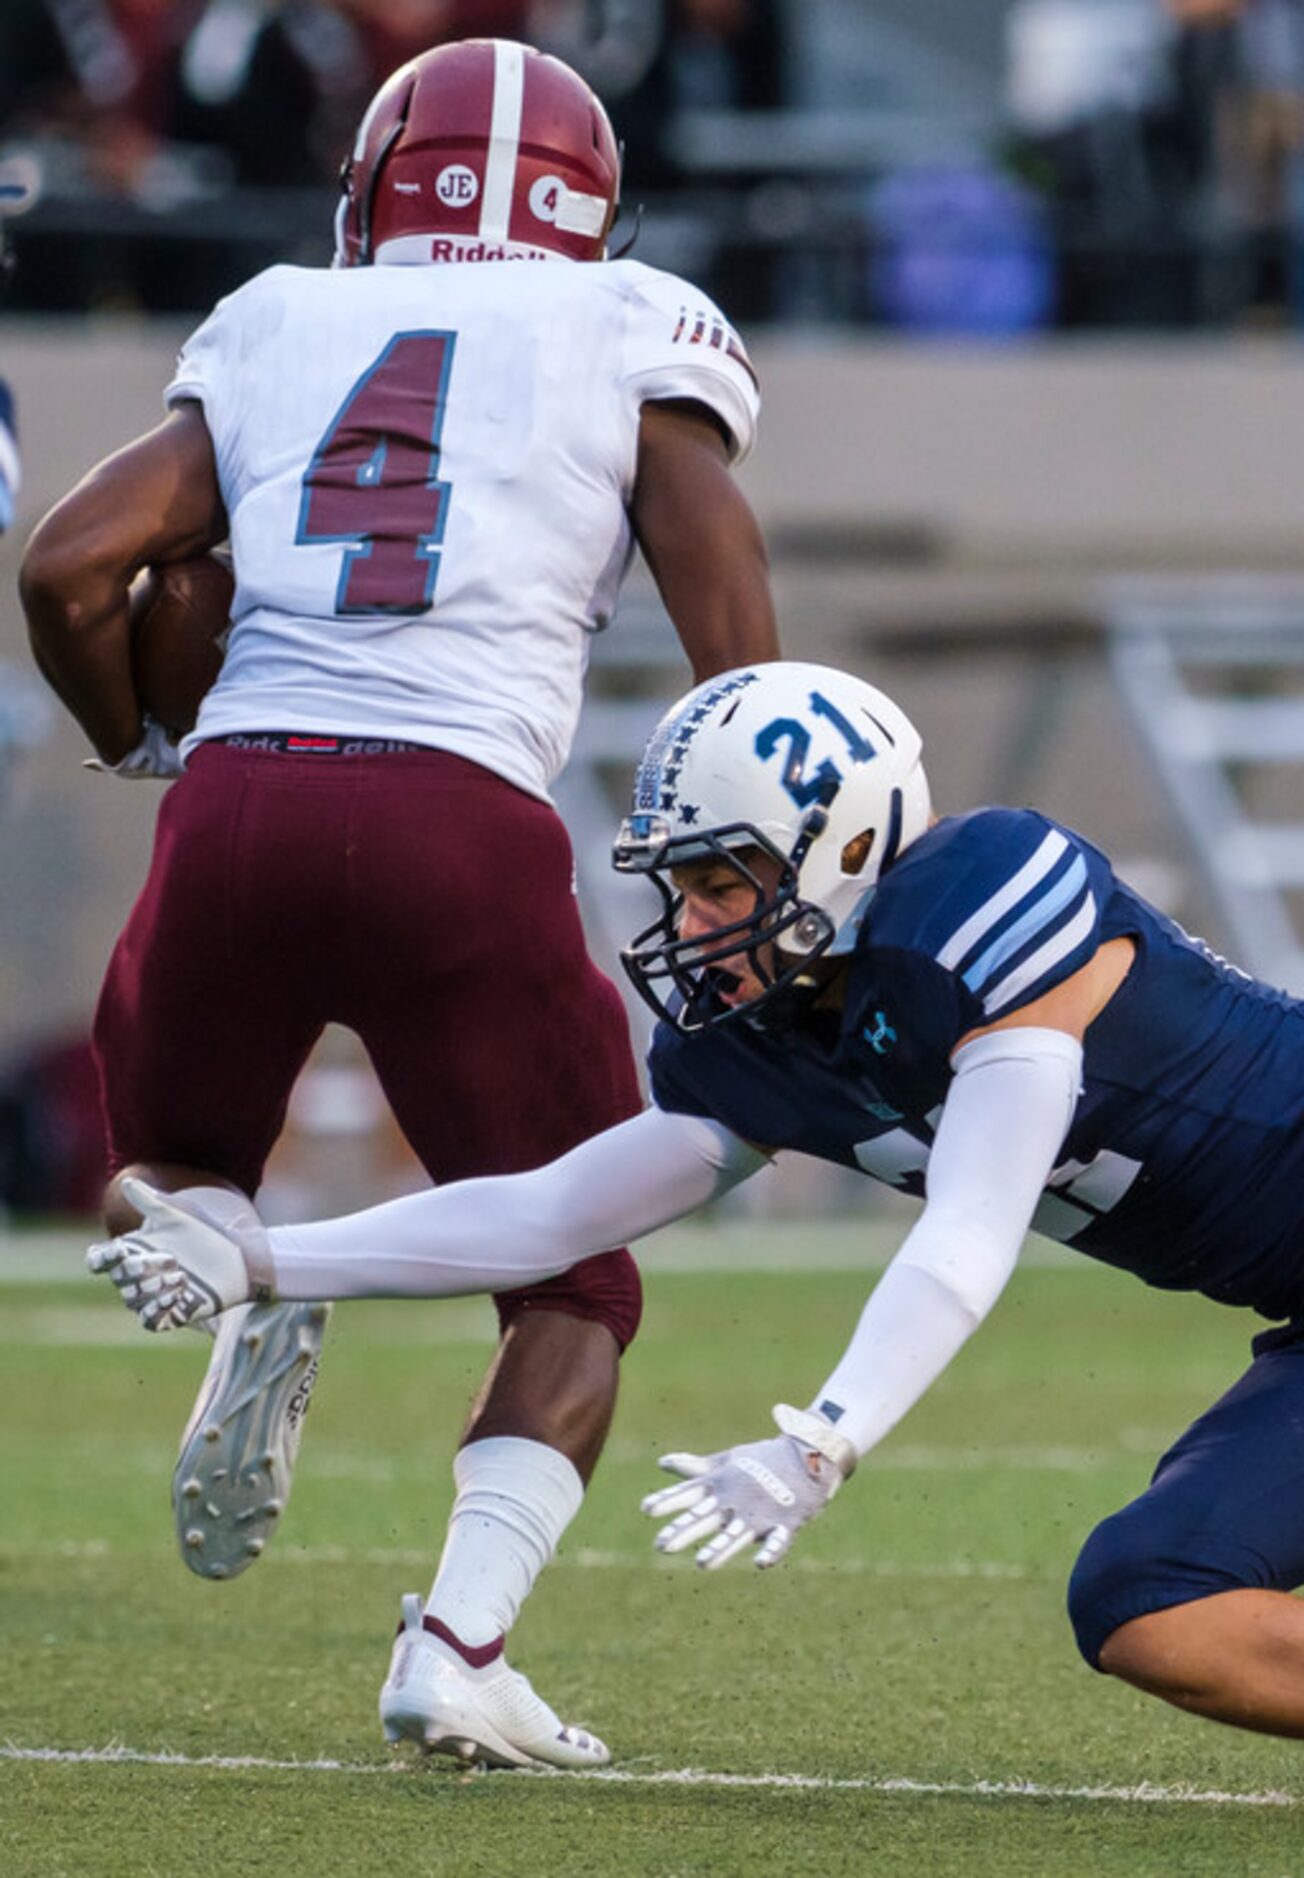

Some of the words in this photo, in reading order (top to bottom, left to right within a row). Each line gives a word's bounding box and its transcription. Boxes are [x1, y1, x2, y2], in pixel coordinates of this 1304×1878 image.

[439, 173, 473, 199] JE
[294, 328, 458, 616] 4
[754, 690, 877, 812] 21
